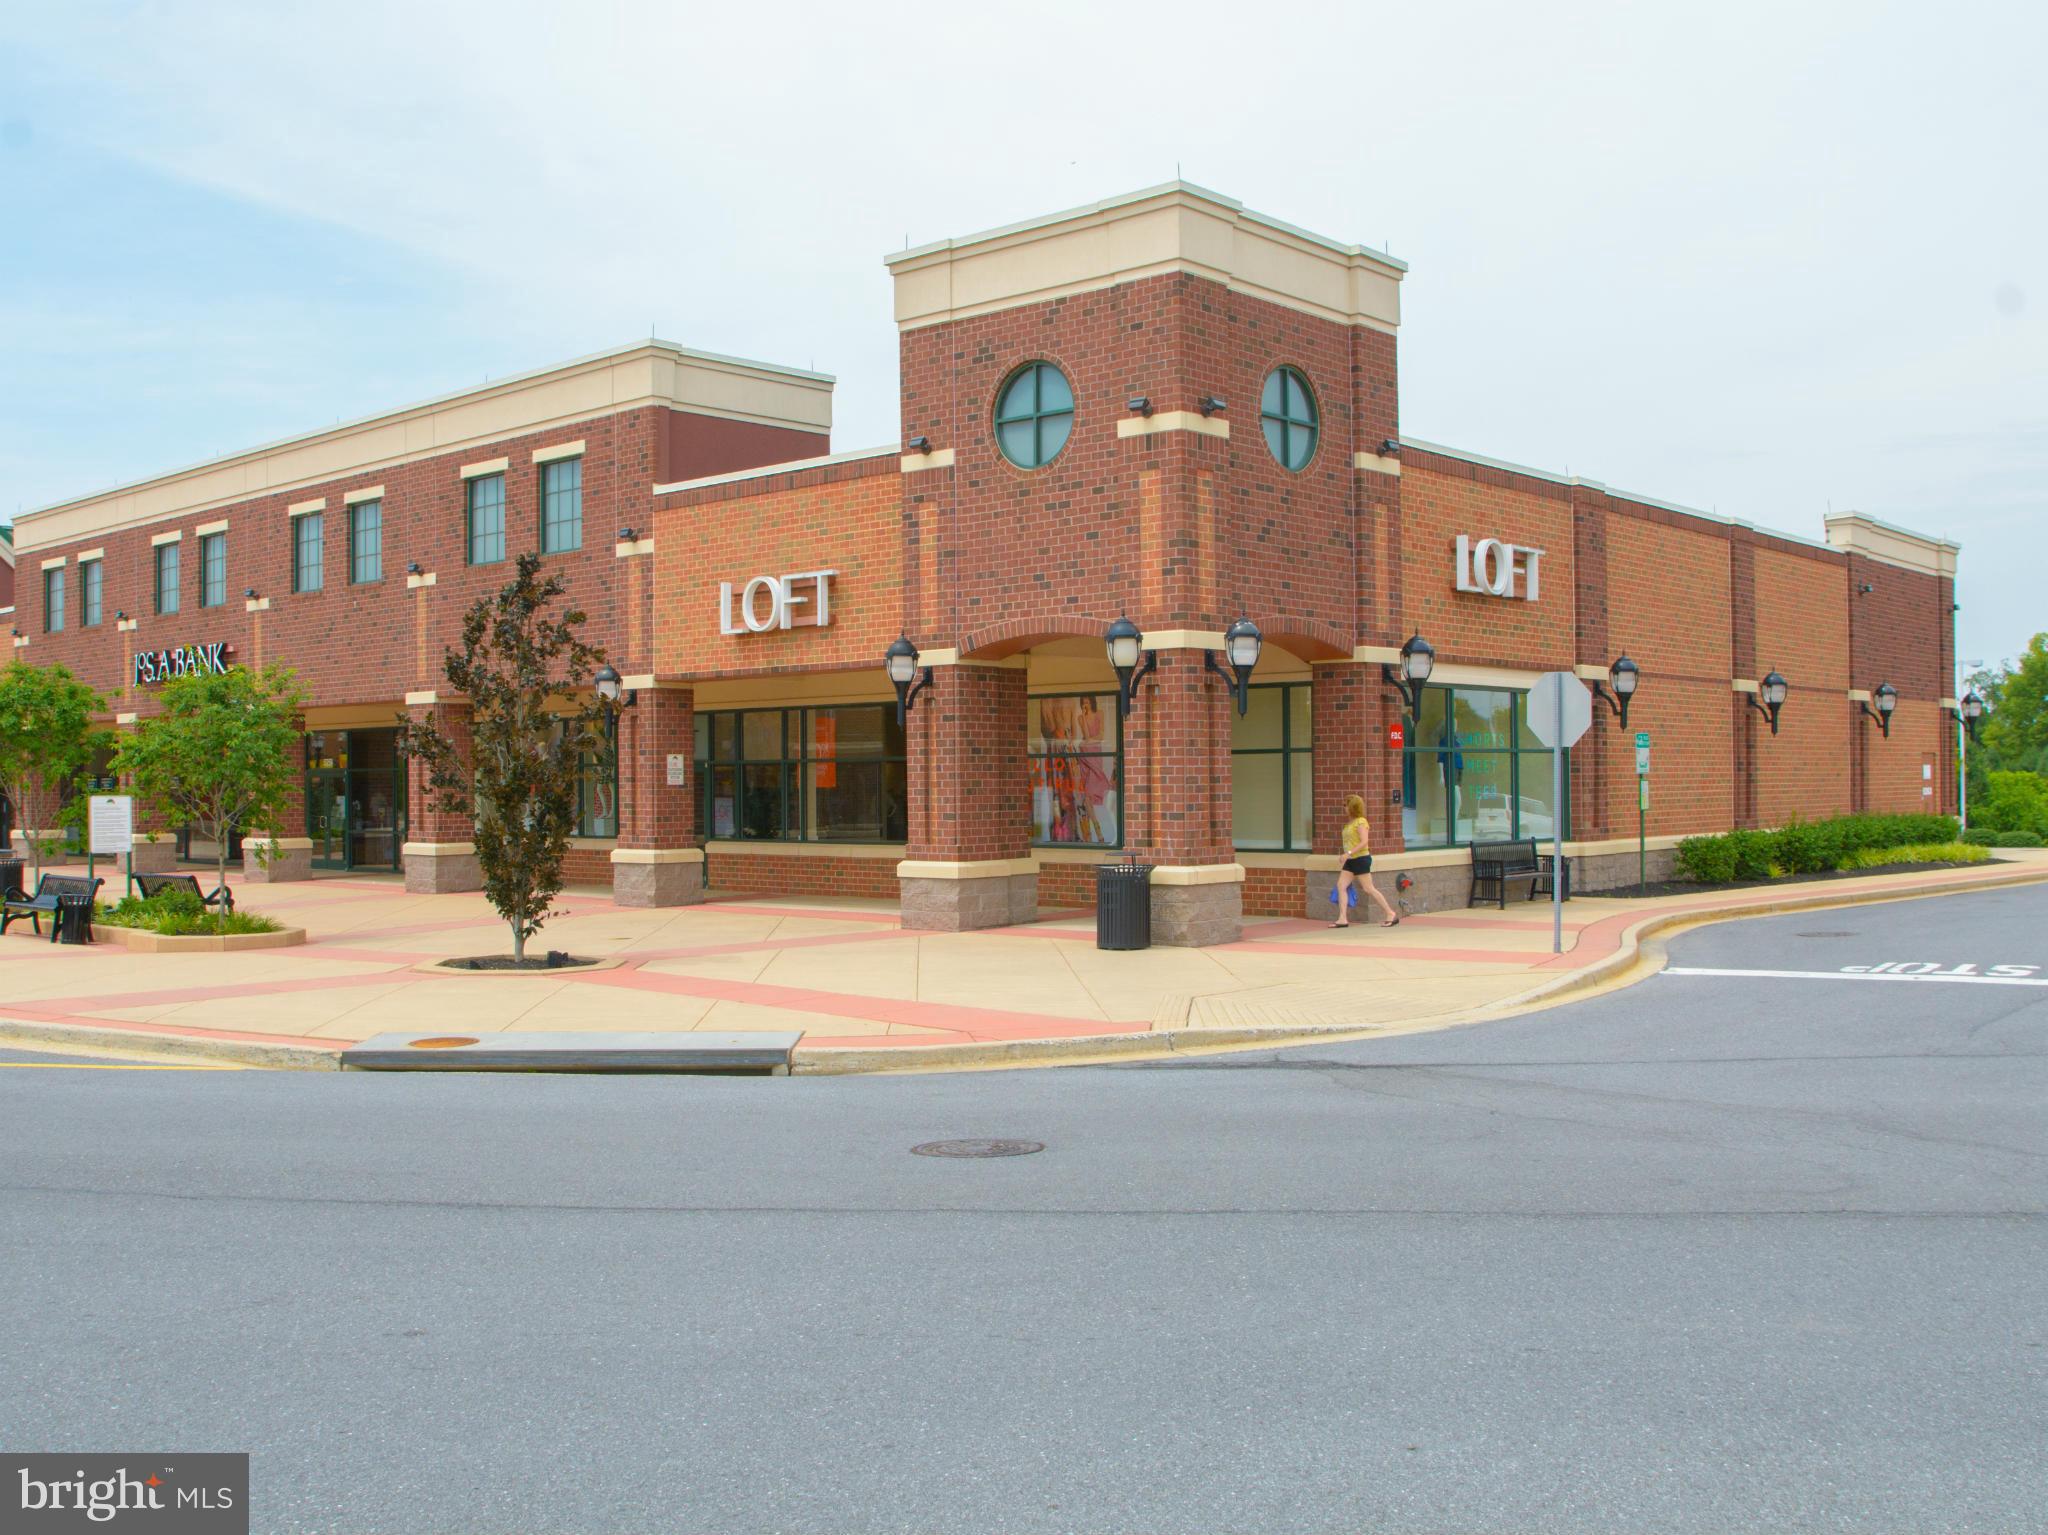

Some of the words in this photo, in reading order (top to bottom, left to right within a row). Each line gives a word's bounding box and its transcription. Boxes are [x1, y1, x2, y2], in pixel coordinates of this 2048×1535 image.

[1456, 535, 1546, 601] LOFT
[720, 569, 839, 634] LOFT
[156, 650, 170, 681] A
[174, 642, 227, 679] BANK
[1840, 961, 2041, 977] STOP
